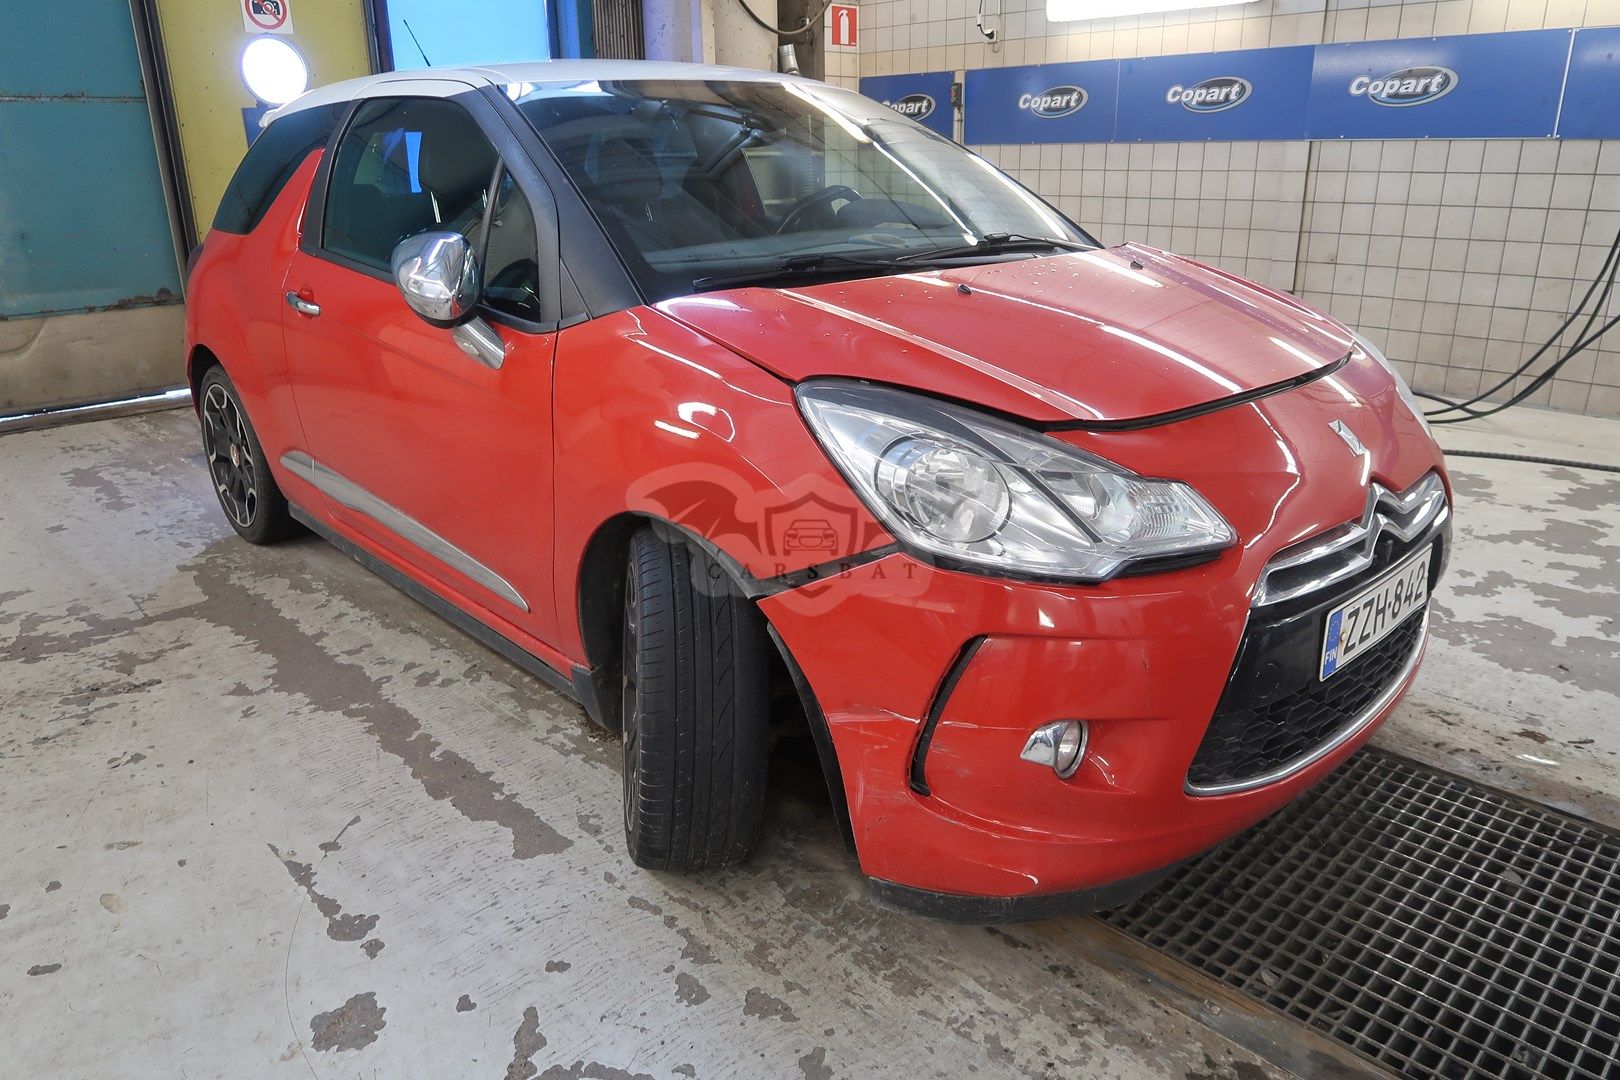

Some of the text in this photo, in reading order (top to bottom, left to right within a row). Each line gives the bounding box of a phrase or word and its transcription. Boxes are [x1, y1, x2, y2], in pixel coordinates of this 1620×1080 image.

[1167, 83, 1240, 105] Copart
[1350, 74, 1442, 98] Copart
[1019, 92, 1078, 111] Copart
[1343, 560, 1426, 656] ZZH-842
[1324, 646, 1338, 666] FIN
